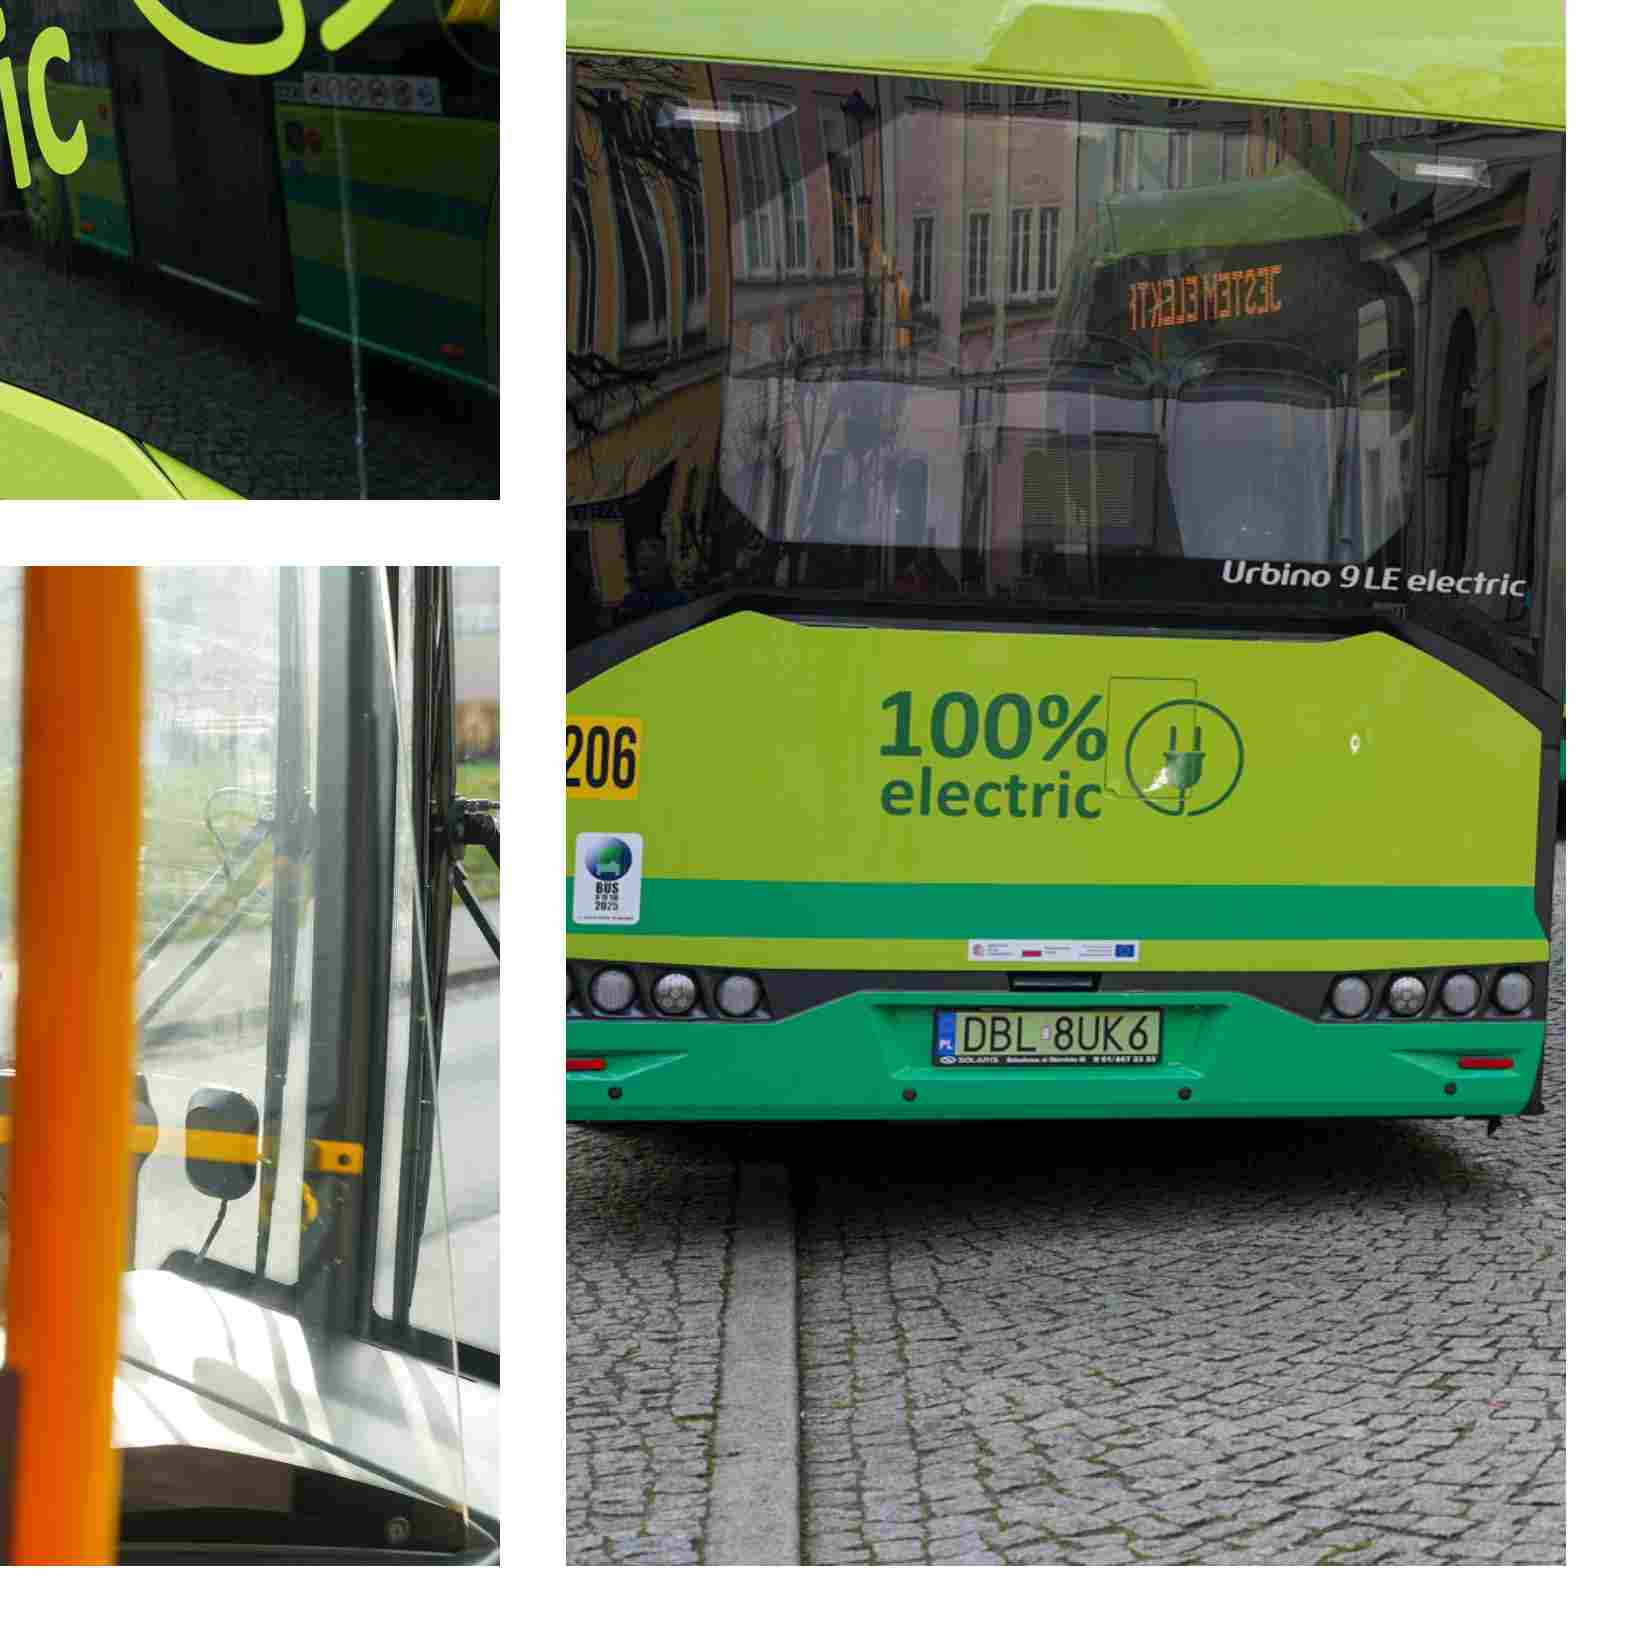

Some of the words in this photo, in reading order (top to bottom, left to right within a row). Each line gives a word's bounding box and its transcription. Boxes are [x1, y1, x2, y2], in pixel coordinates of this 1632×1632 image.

[1222, 560, 1331, 588] Urbino
[1340, 565, 1360, 589] 9
[1363, 567, 1402, 591] LE
[1407, 569, 1528, 597] electric
[880, 691, 1107, 761] 100%
[565, 725, 636, 788] 206
[880, 766, 1101, 819] electric
[595, 881, 619, 894] BUS
[963, 1016, 1037, 1052] DBL
[1054, 1016, 1149, 1052] 8UK6
